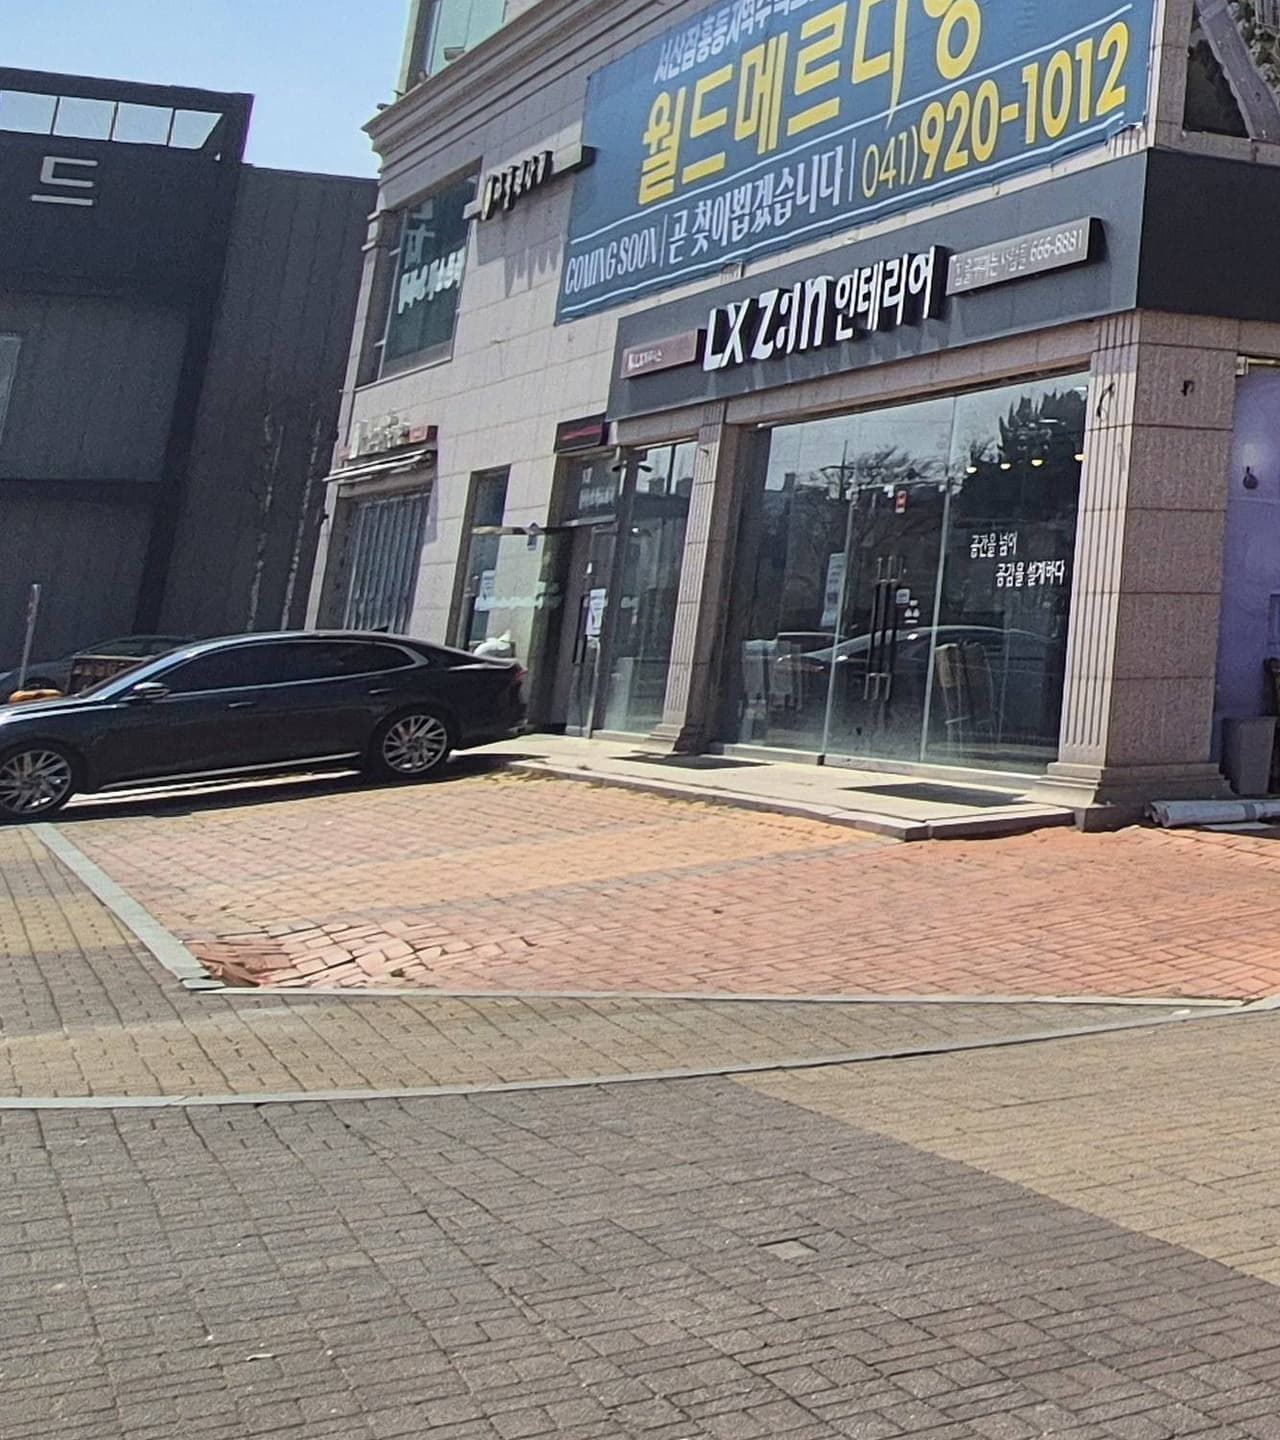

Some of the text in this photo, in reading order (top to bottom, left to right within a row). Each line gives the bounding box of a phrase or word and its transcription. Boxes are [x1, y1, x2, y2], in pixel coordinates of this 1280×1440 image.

[1030, 229, 1083, 262] 666-8881
[703, 297, 756, 371] LX
[835, 246, 937, 340] 인테리어
